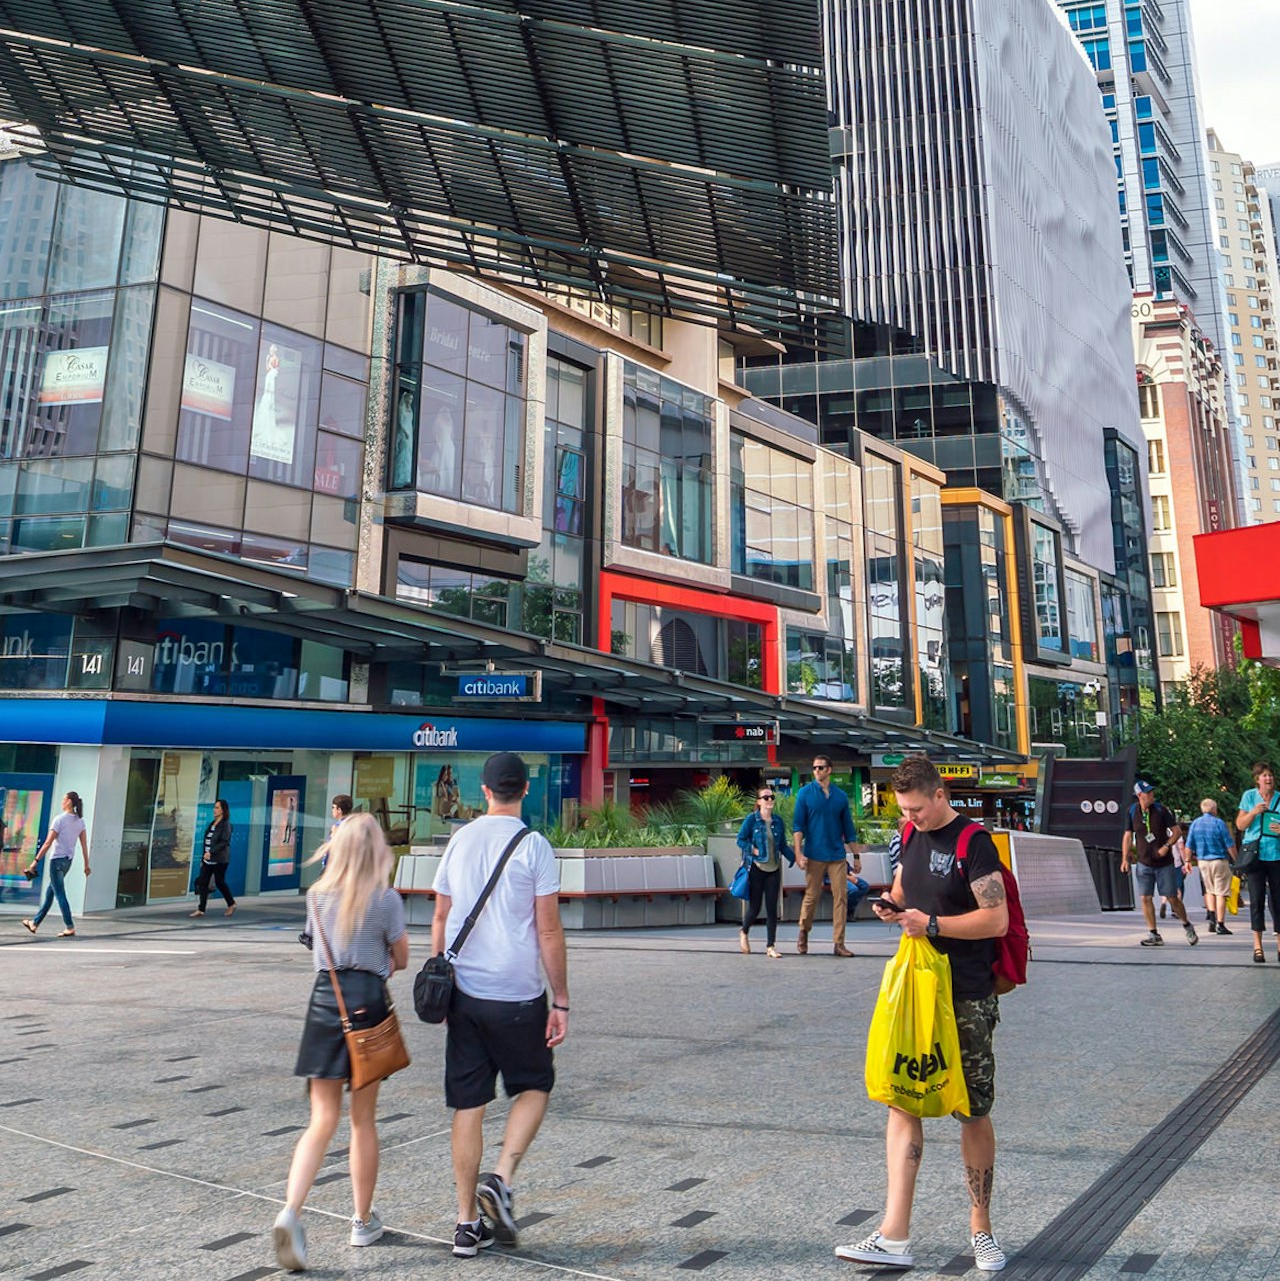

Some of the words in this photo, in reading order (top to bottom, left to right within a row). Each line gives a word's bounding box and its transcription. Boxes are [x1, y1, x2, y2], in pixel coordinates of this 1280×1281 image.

[315, 472, 338, 490] SALE
[82, 655, 101, 673] 141
[128, 656, 144, 675] 141
[464, 679, 520, 695] citibank
[413, 726, 458, 747] citibank
[746, 725, 764, 737] nab
